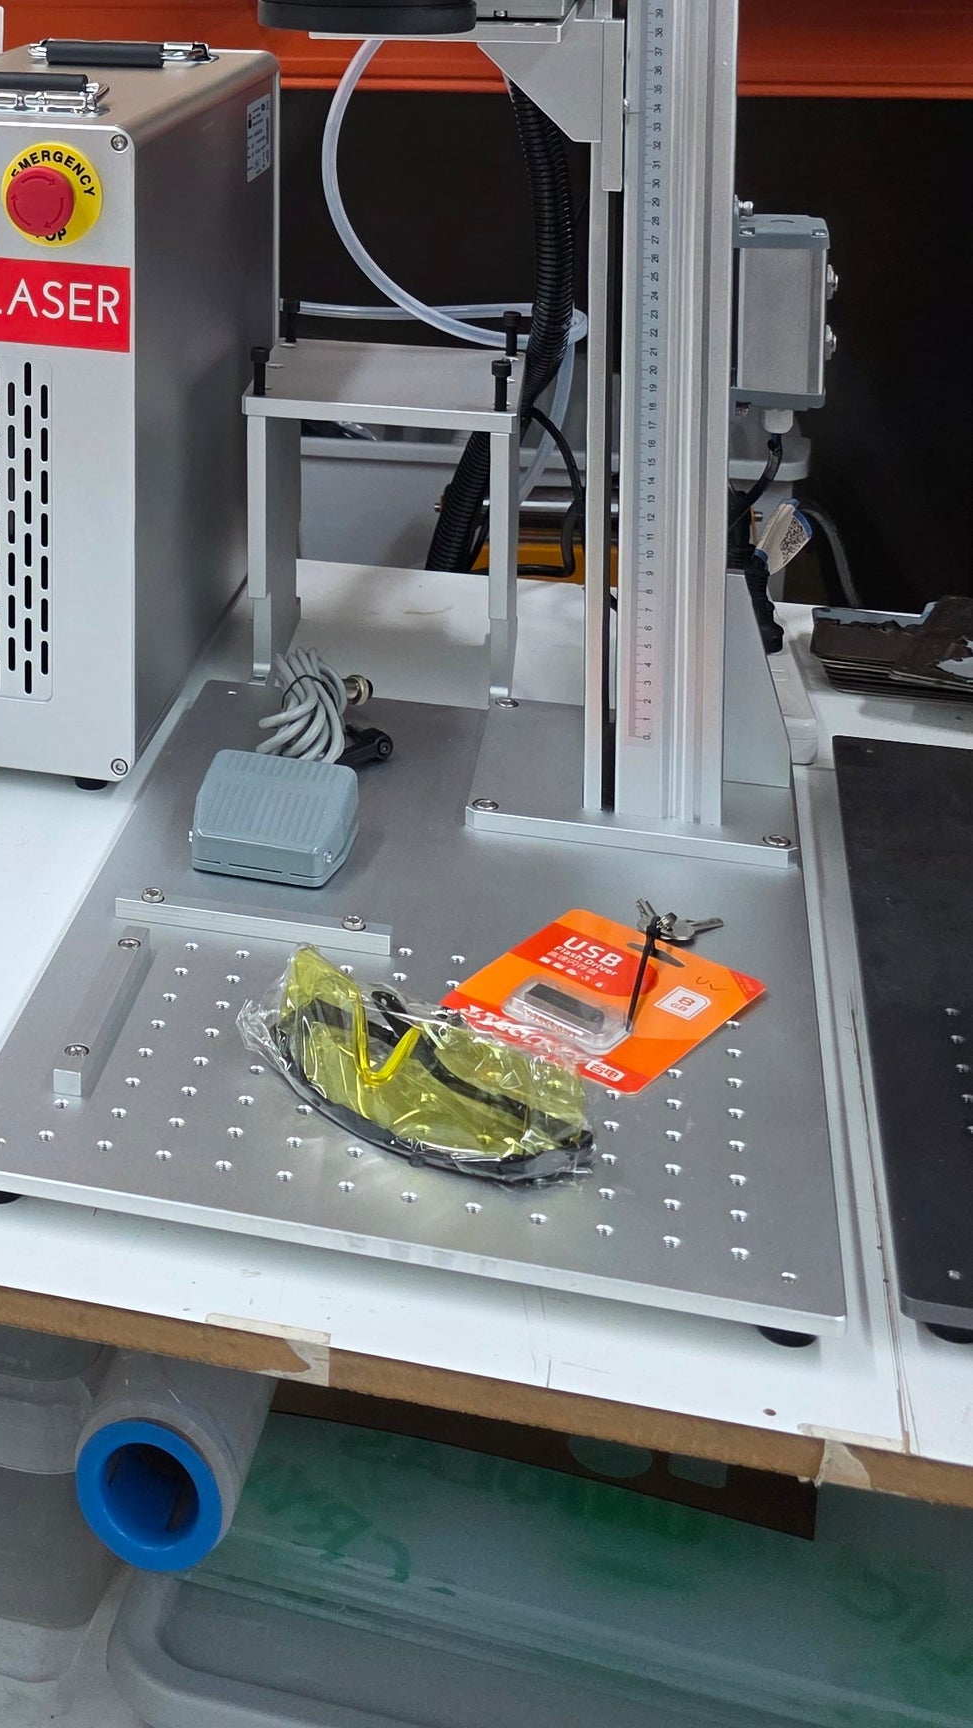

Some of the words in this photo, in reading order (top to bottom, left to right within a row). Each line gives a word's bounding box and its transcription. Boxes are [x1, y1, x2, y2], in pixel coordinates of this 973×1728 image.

[655, 9, 663, 18] 39
[655, 28, 663, 37] 38
[655, 47, 663, 56] 37
[654, 104, 661, 113] 34
[653, 122, 661, 132] 33
[653, 141, 661, 150] 32
[652, 161, 660, 169] 31
[652, 179, 660, 188] 30
[652, 198, 660, 207] 29
[652, 217, 660, 226] 28
[651, 235, 659, 244] 27
[651, 272, 659, 282] 25
[651, 291, 658, 300] 24
[650, 310, 658, 319] 23
[650, 329, 658, 337] 22
[650, 348, 657, 356] 21
[649, 365, 657, 375] 20
[649, 384, 657, 392] 19
[648, 421, 656, 429] 17
[648, 458, 655, 466] 15
[647, 495, 655, 503] 13
[647, 513, 655, 521] 12
[646, 550, 654, 558] 10
[563, 936, 623, 967] USB
[553, 945, 583, 961] Flash
[584, 959, 618, 976] Driver
[678, 996, 696, 1007] 8
[670, 1002, 688, 1011] GB
